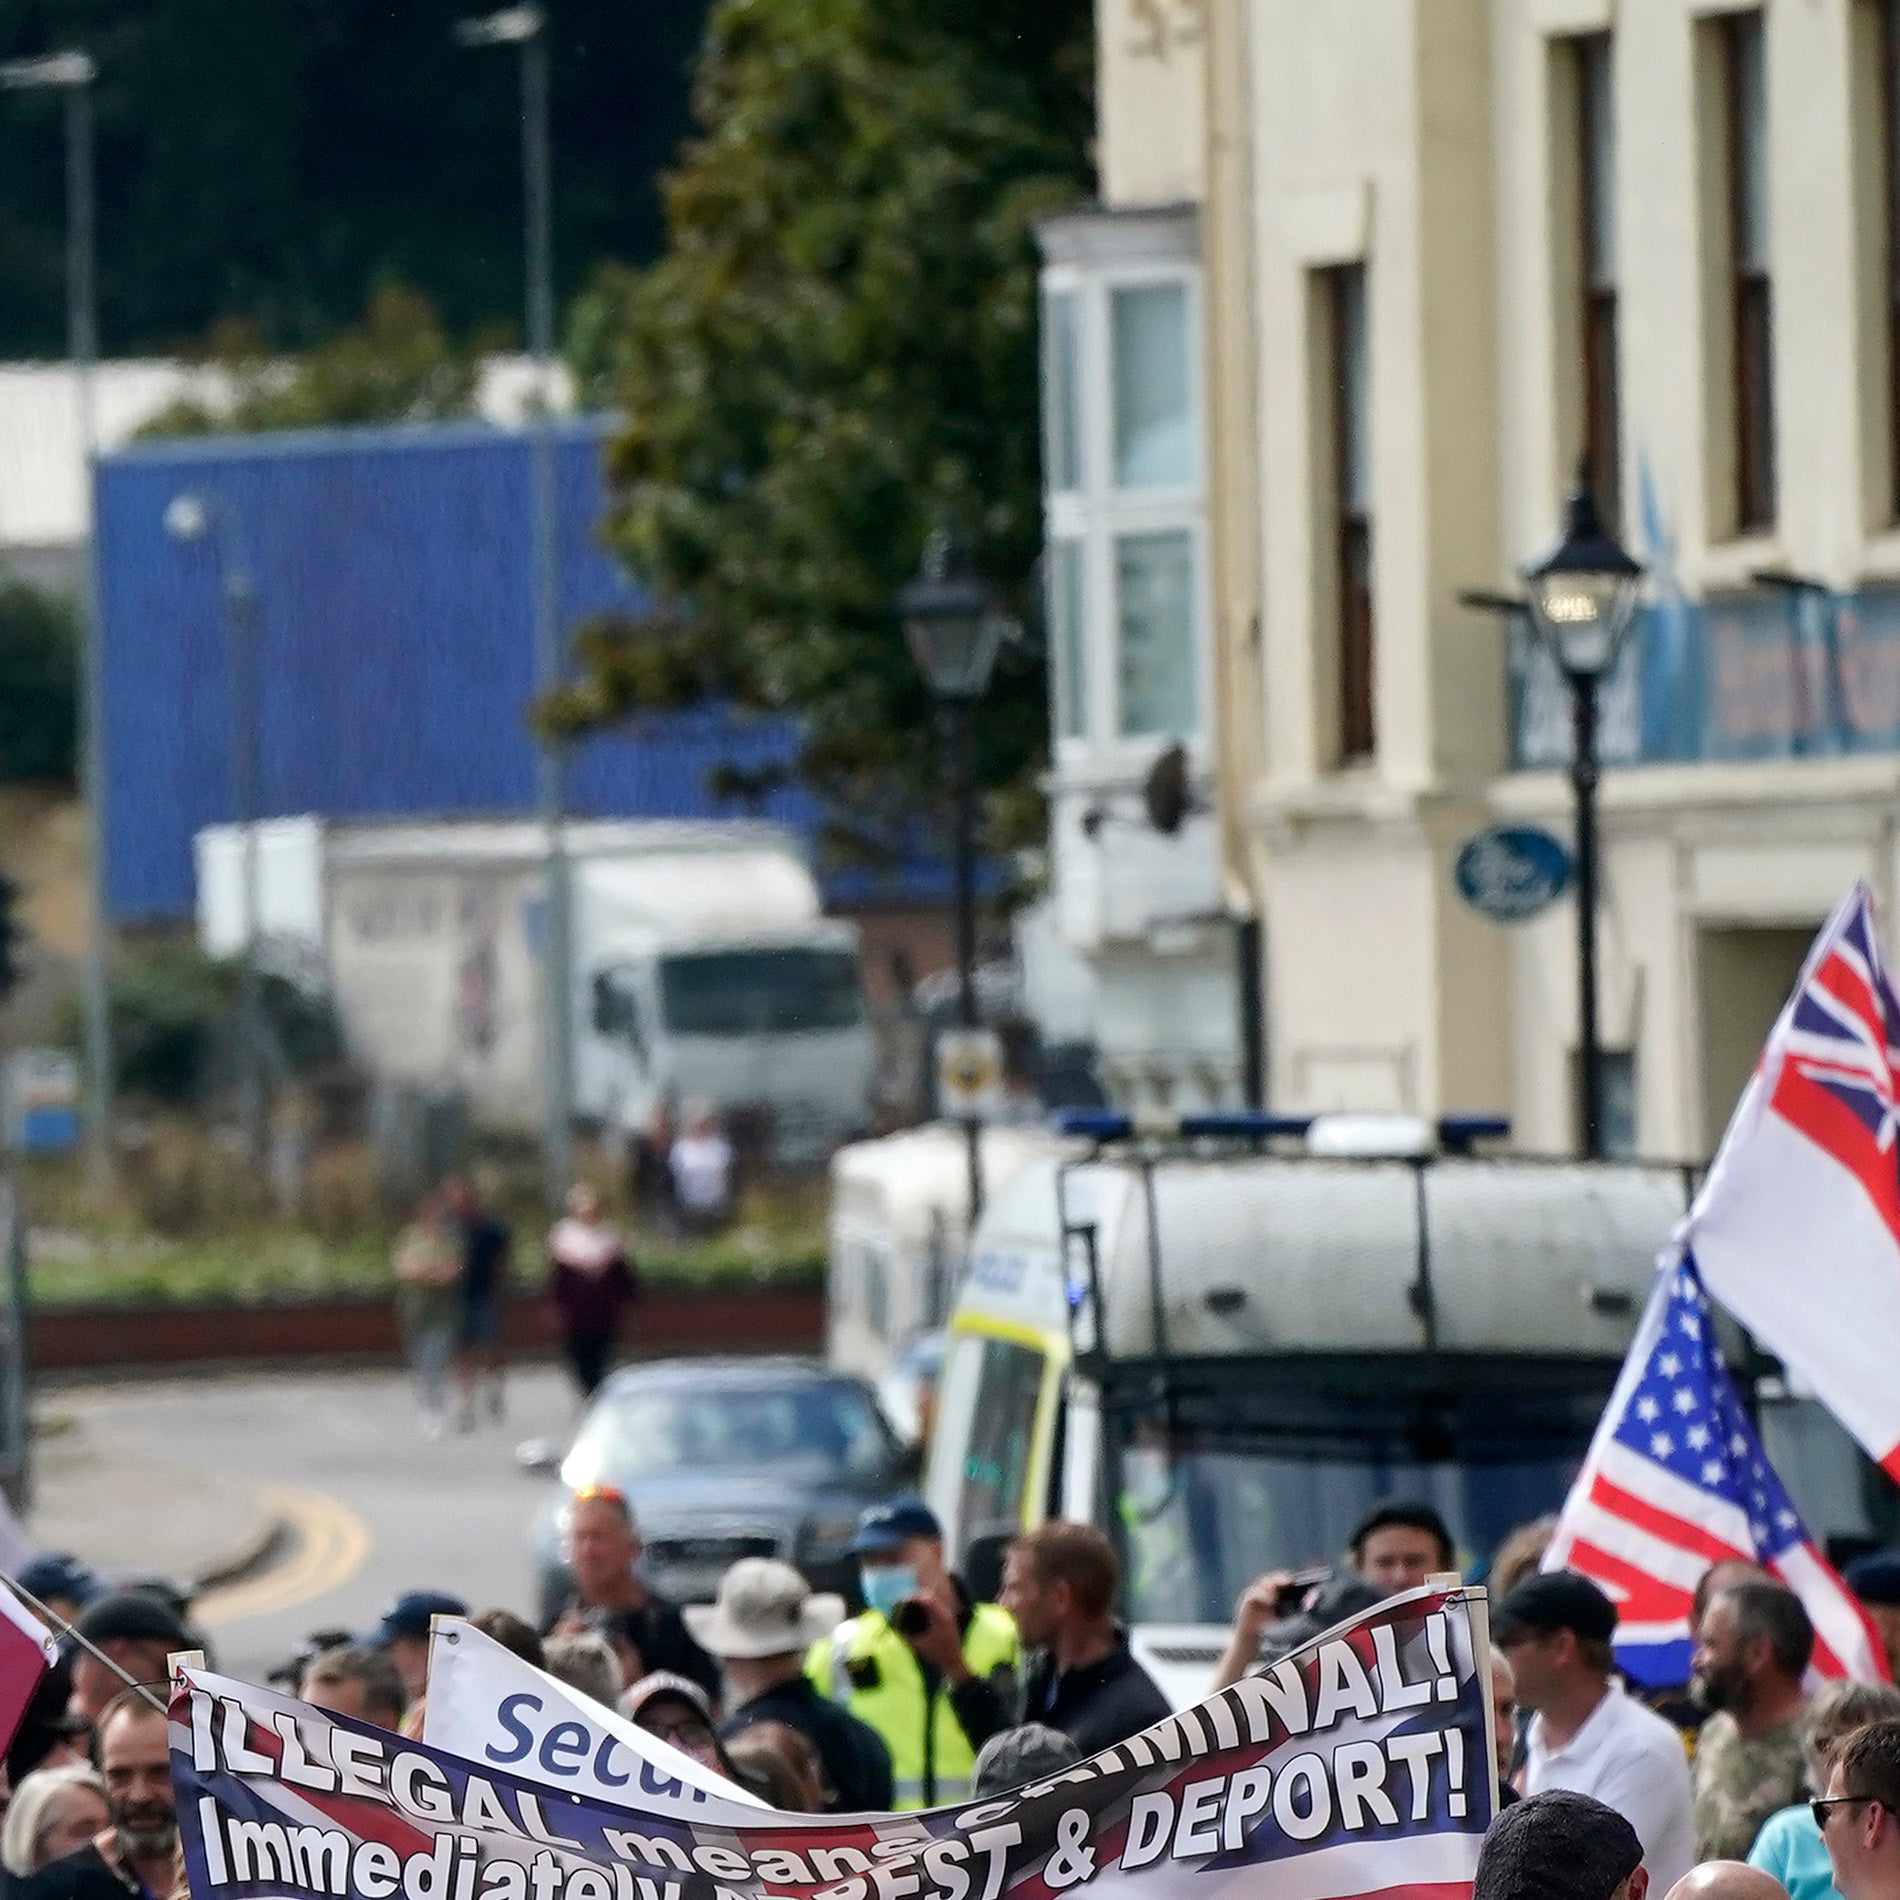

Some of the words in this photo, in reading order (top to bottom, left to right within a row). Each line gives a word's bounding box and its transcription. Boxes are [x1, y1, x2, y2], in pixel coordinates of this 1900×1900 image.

[188, 1688, 585, 1851] ILLEGAL
[602, 1826, 924, 1885] means
[484, 1693, 707, 1803] Secu
[1043, 1806, 1097, 1889] &
[1121, 1727, 1468, 1871] DEPORT!
